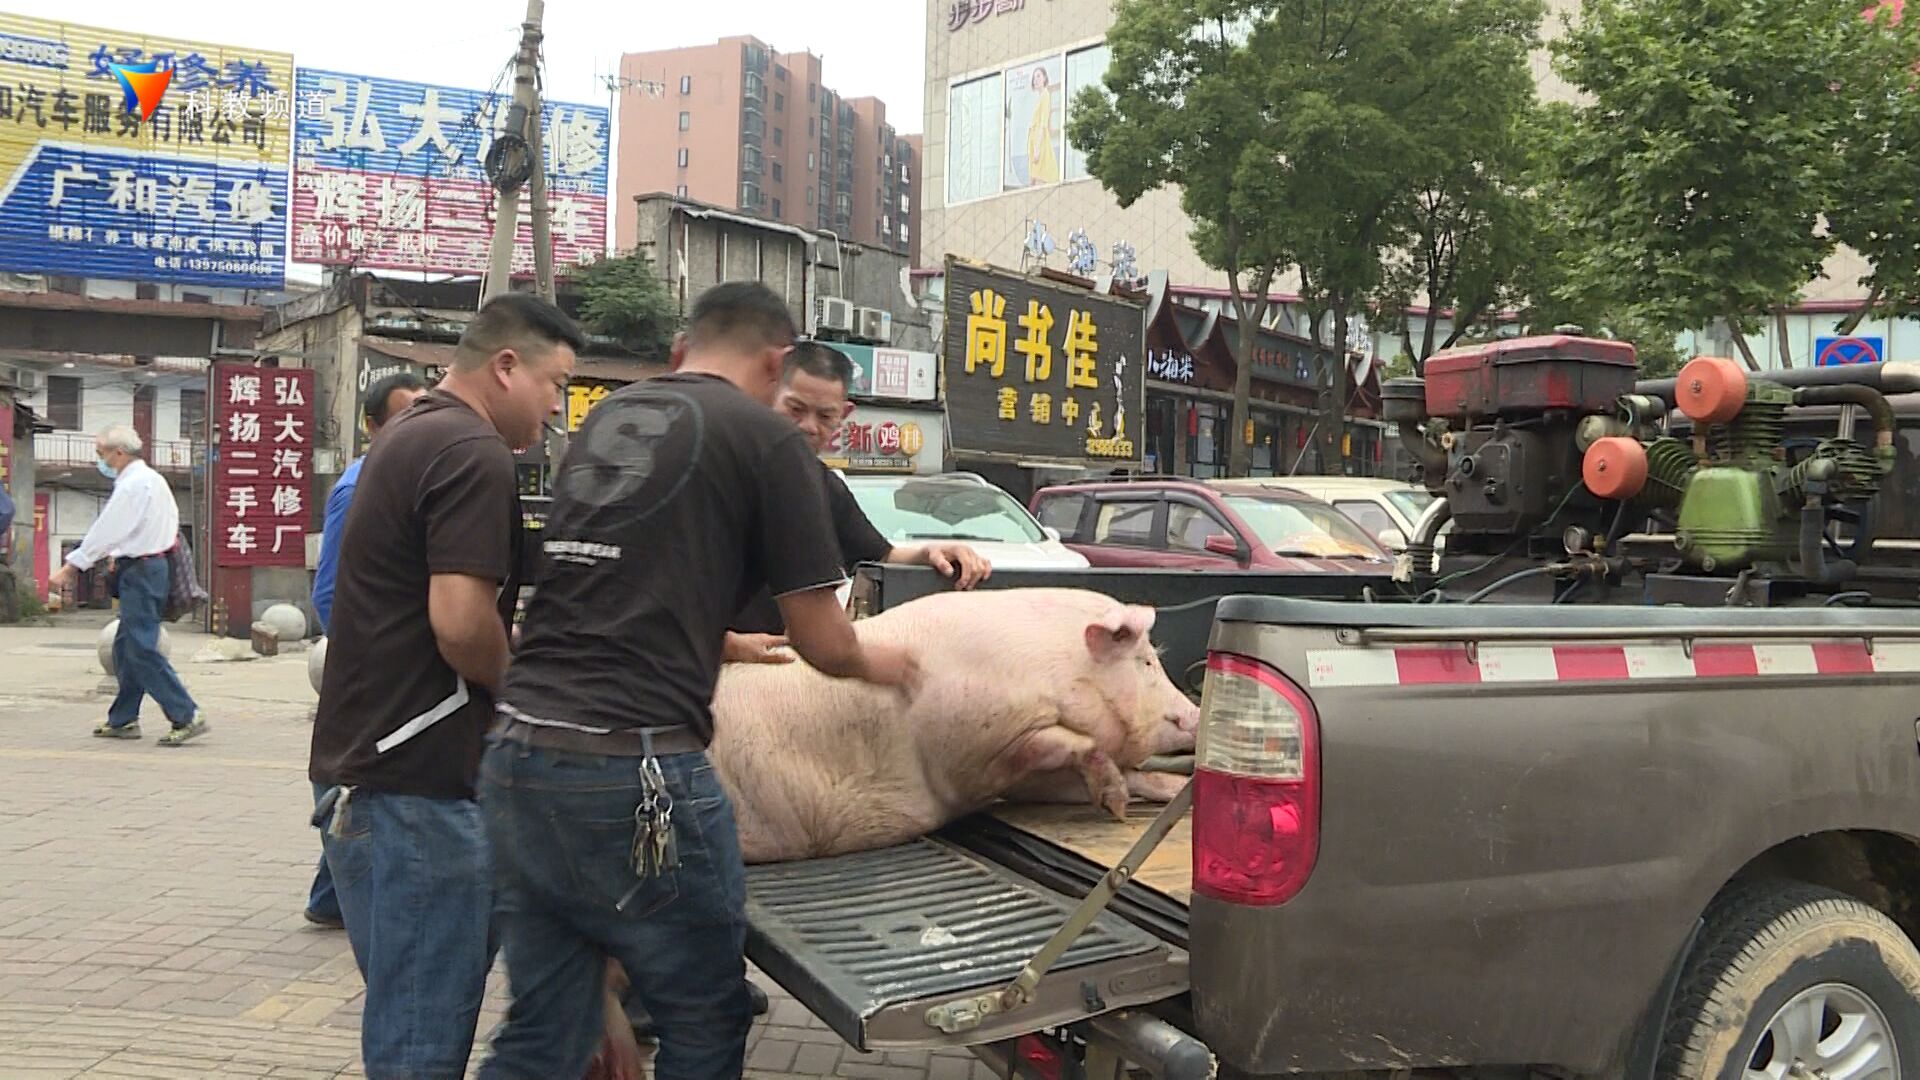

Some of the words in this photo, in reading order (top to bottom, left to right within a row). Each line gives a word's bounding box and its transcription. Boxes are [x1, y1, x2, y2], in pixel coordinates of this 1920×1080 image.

[48, 163, 277, 224] 广和汽修
[964, 289, 1099, 389] 尚书佳
[227, 374, 261, 555] 辉扬二手车
[272, 376, 305, 554] 弘大汽修厂
